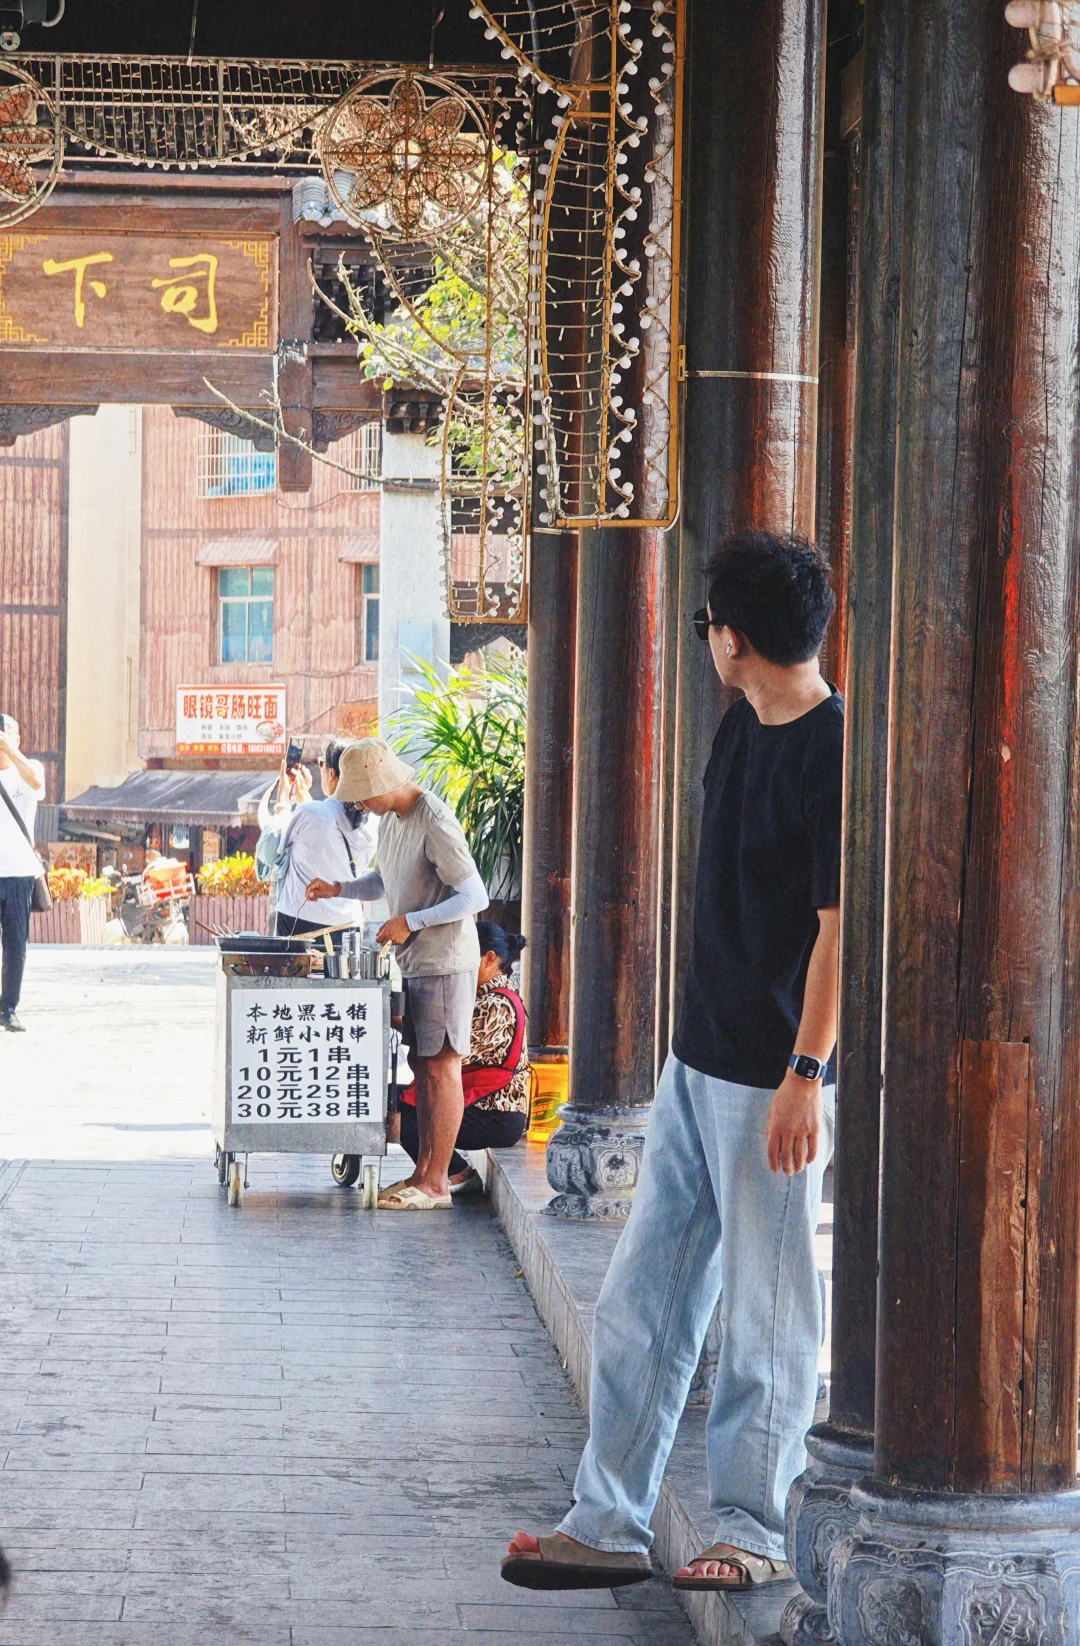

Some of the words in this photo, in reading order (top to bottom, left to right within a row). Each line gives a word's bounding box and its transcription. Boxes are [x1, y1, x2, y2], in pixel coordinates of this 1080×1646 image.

[43, 252, 218, 333] 下司
[183, 694, 278, 719] 眼镜哥肠旺面
[246, 1002, 368, 1022] 本地黑毛猪
[246, 1025, 368, 1044] 新鲜小肉串
[258, 1046, 351, 1064] 1元1串
[239, 1064, 370, 1082] 10元12串
[237, 1082, 370, 1100] 20元25串
[237, 1100, 370, 1119] 30元38串
